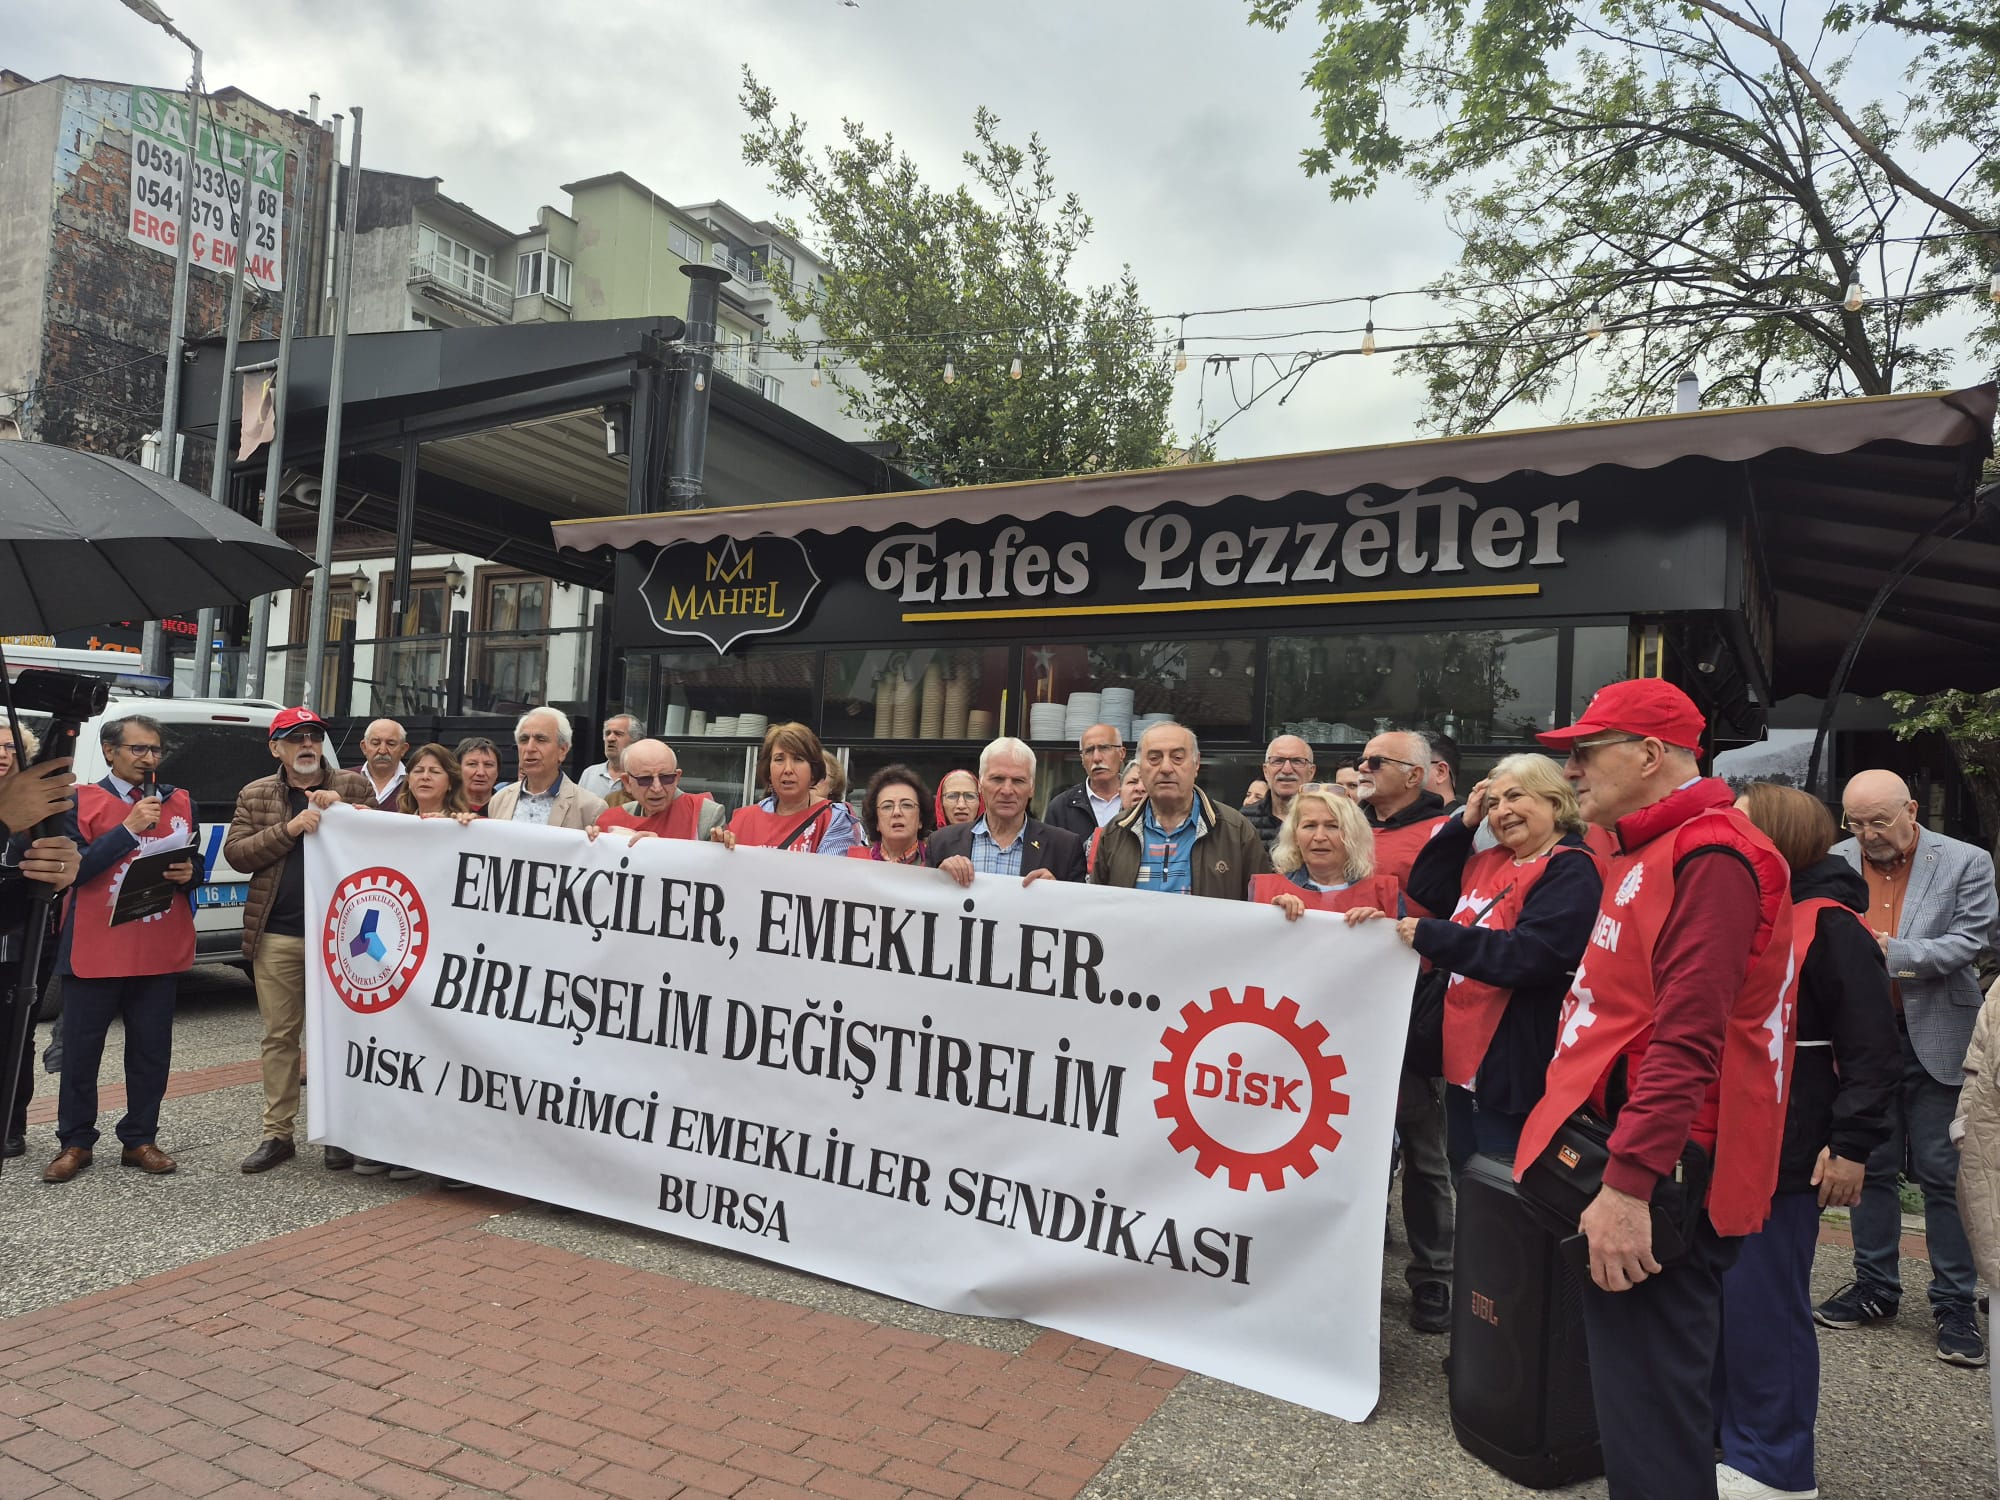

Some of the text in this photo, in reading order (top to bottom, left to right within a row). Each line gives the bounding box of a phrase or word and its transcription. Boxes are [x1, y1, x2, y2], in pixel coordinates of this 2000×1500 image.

[137, 139, 183, 182] 0531
[258, 189, 277, 218] 68
[137, 175, 182, 215] 0541
[192, 196, 224, 231] 379
[255, 222, 275, 251] 25
[133, 208, 206, 262] ERGÇ
[664, 581, 784, 621] MAHFEL
[866, 526, 1089, 603] Enfes
[205, 886, 238, 901] 16 A
[451, 852, 1161, 1012] EMEKÇİLER, EMEKLİLER...
[431, 943, 1126, 1137] BİRLEŞELİM DEĞİŞTİRELİM
[1193, 1052, 1303, 1113] DİSK
[345, 1036, 1254, 1285] DİSK / DEVRİMCİ EMEKLİLER SENDİKASI
[658, 1173, 790, 1243] BURSA
[1471, 1290, 1498, 1327] JBL
